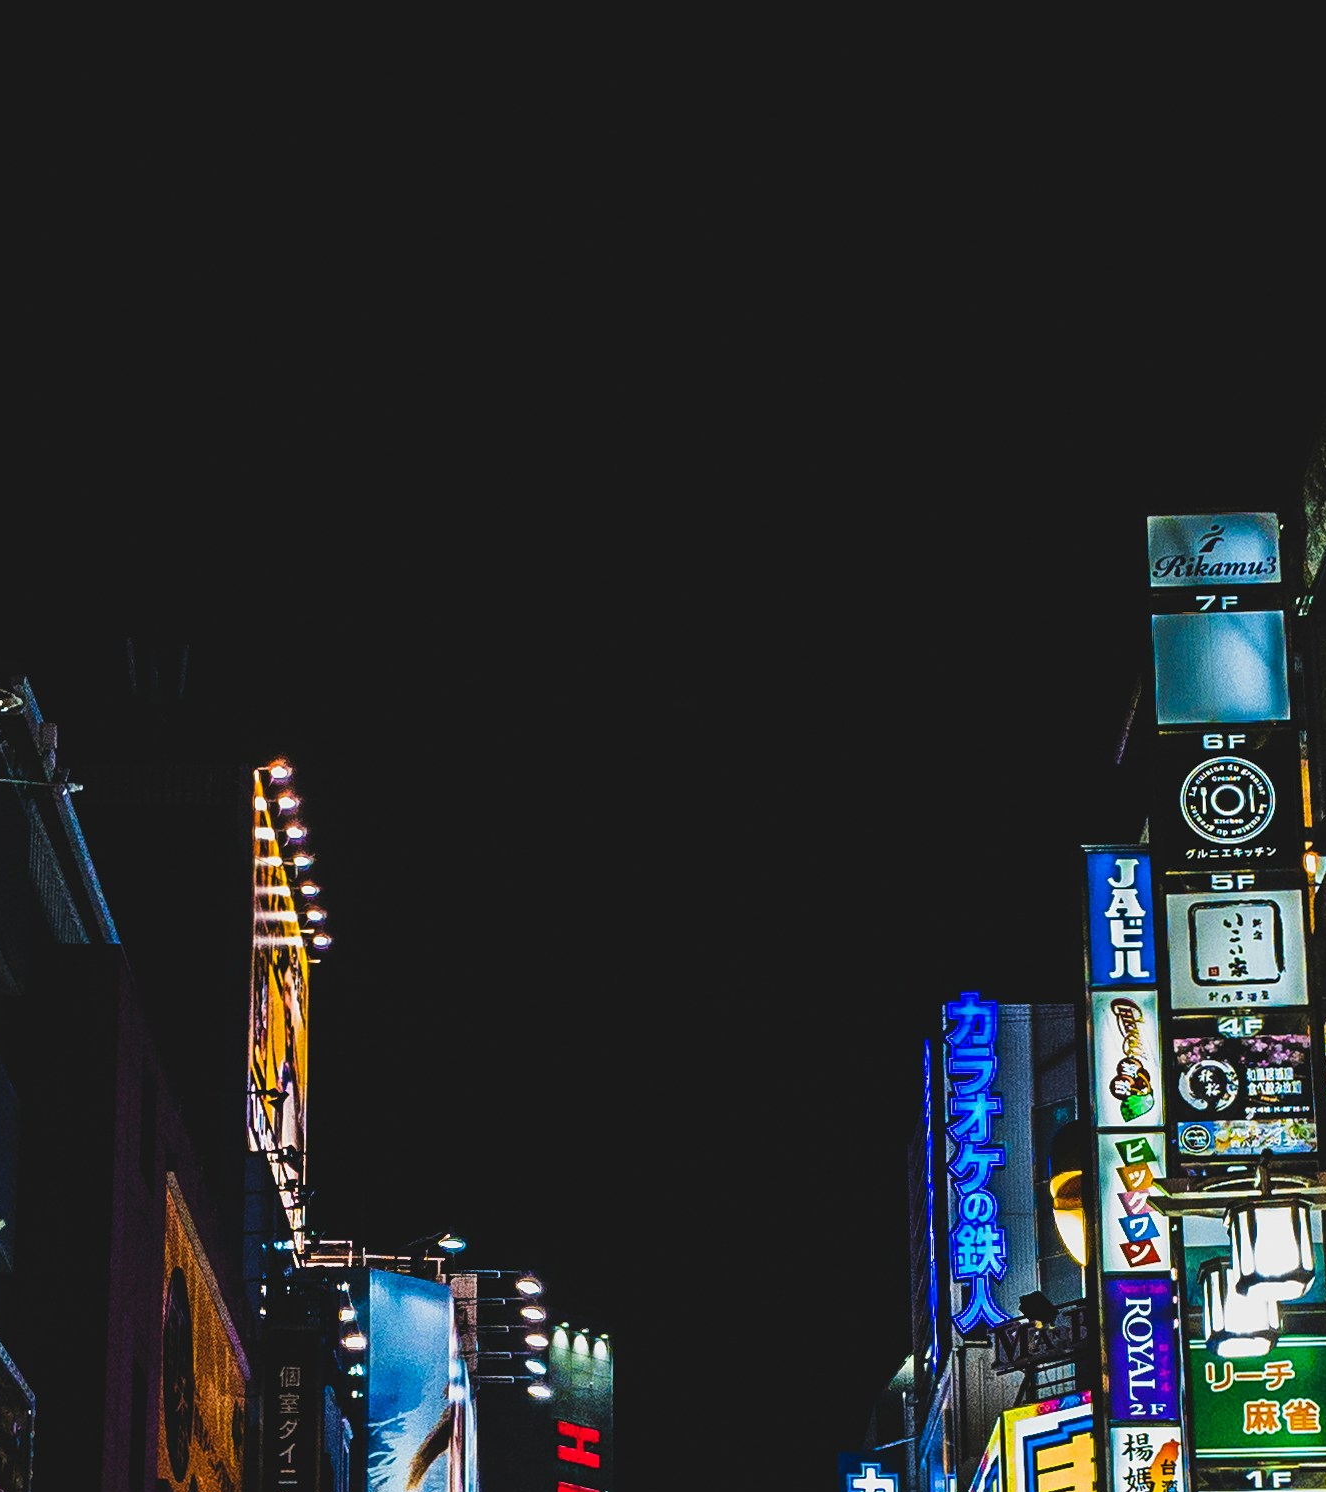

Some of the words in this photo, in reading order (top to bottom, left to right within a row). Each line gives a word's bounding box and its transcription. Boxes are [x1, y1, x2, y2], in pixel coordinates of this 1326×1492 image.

[1195, 595, 1238, 611] 7F
[1203, 734, 1246, 750] 6F
[1184, 845, 1277, 860] グルニエキッチン
[1210, 873, 1256, 890] 5F
[1105, 858, 1150, 979] JAビル
[1217, 1017, 1263, 1035] 4F
[946, 991, 1012, 1335] カラオケの鉄人
[1124, 1297, 1156, 1405] ROYAL
[1205, 1362, 1297, 1391] リーチ
[1129, 1402, 1167, 1416] 2F
[1243, 1399, 1322, 1434] 麻雀
[1245, 1471, 1292, 1489] 1F
